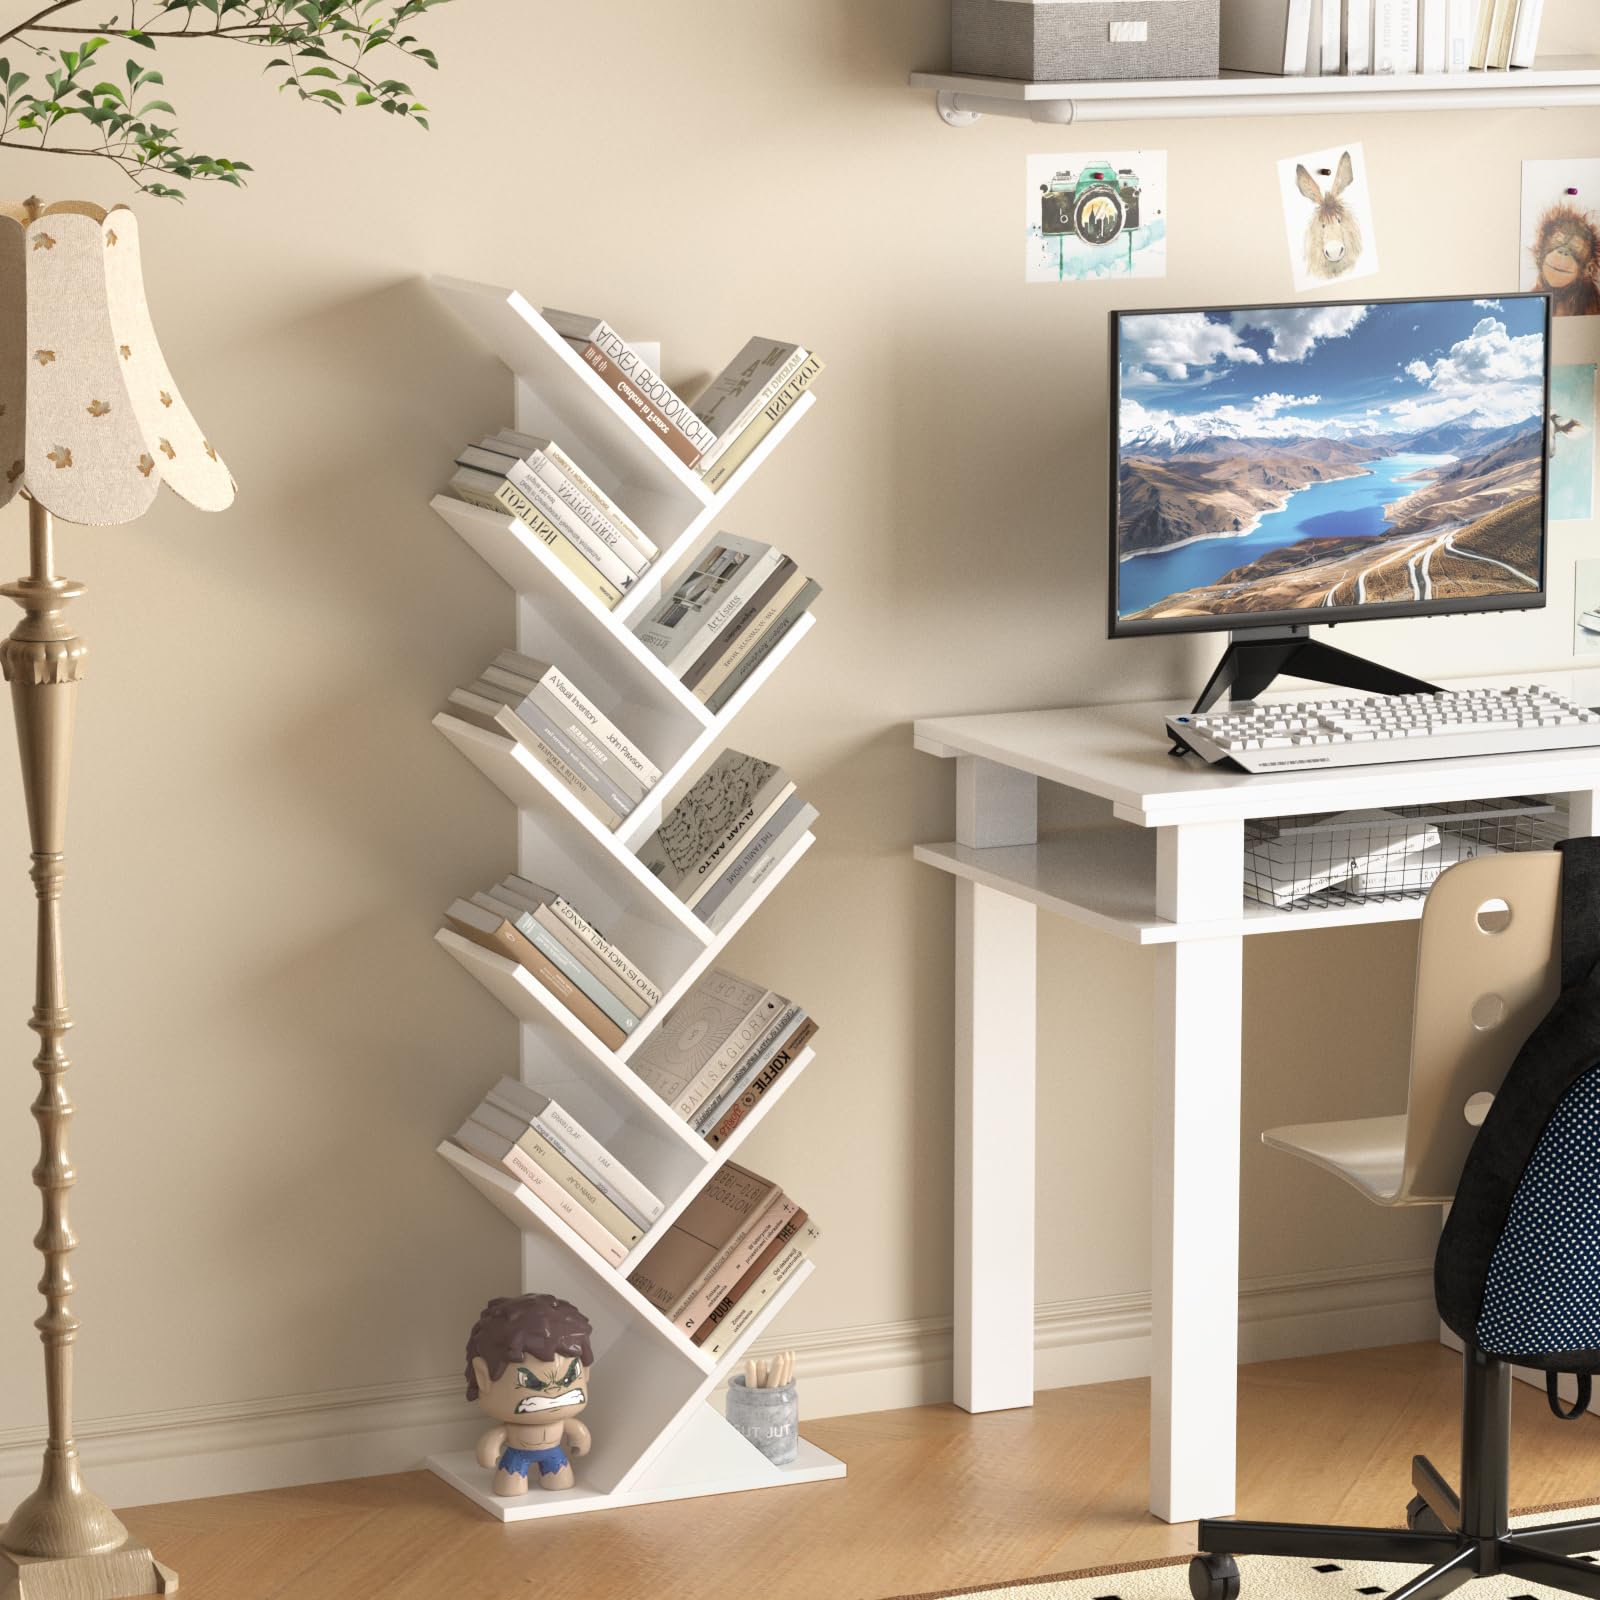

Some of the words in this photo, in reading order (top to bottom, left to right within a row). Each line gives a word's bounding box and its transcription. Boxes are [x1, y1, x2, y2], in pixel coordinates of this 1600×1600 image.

[549, 675, 557, 684] A
[555, 681, 573, 702] Visual
[571, 695, 599, 725] Inventory
[606, 733, 622, 751] John
[620, 746, 644, 771] Pawson
[564, 769, 588, 792] BEYOND
[728, 810, 754, 841] ALVAR
[761, 832, 773, 845] THE
[698, 842, 726, 874] AALTO
[742, 842, 764, 867] FAMILY
[727, 863, 744, 885] HOME
[561, 907, 591, 932] JANG?
[590, 932, 626, 972] MICHAEL
[627, 969, 637, 980] IS
[636, 980, 659, 1003] WHO
[718, 1060, 728, 1070] &
[726, 1011, 766, 1059] GLORY
[753, 1051, 791, 1094] KOFFIE
[551, 1112, 569, 1129] ERWIN
[566, 1125, 581, 1140] OLAF
[512, 1157, 530, 1175] ERWIN
[527, 1171, 543, 1186] OLAF
[566, 1176, 581, 1190] OLAF
[580, 1186, 597, 1203] ERWIN
[709, 1297, 734, 1323] PUUR
[777, 1224, 798, 1242] THEE
[766, 1423, 791, 1438] JUT
